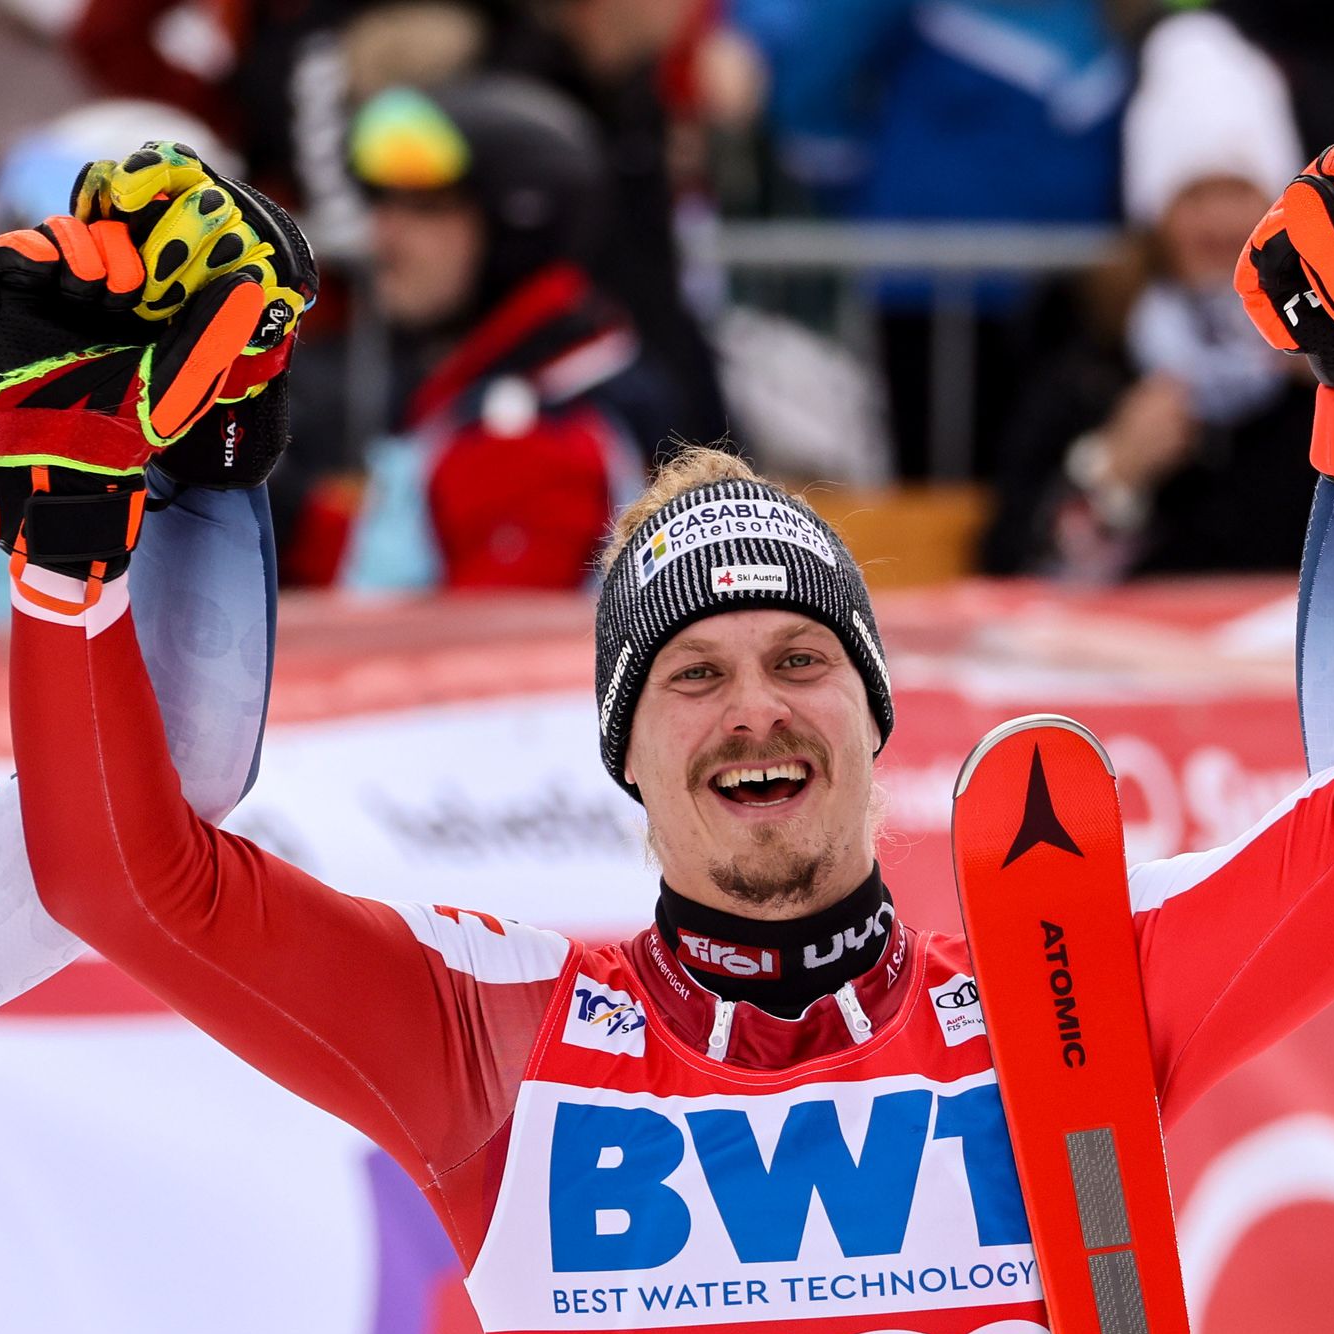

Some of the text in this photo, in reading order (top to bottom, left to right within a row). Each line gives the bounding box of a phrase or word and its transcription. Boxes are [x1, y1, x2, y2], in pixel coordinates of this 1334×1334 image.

[668, 503, 826, 544] CASABLANCA
[671, 519, 829, 558] hotelsoftware
[736, 572, 782, 584] Ski Austria
[1040, 920, 1086, 1069] ATOMIC
[947, 1015, 966, 1026] Audi
[947, 1023, 961, 1032] FIS
[549, 1083, 1033, 1273] BWT
[553, 1260, 1036, 1314] BEST WATER TECHNOLOGY
